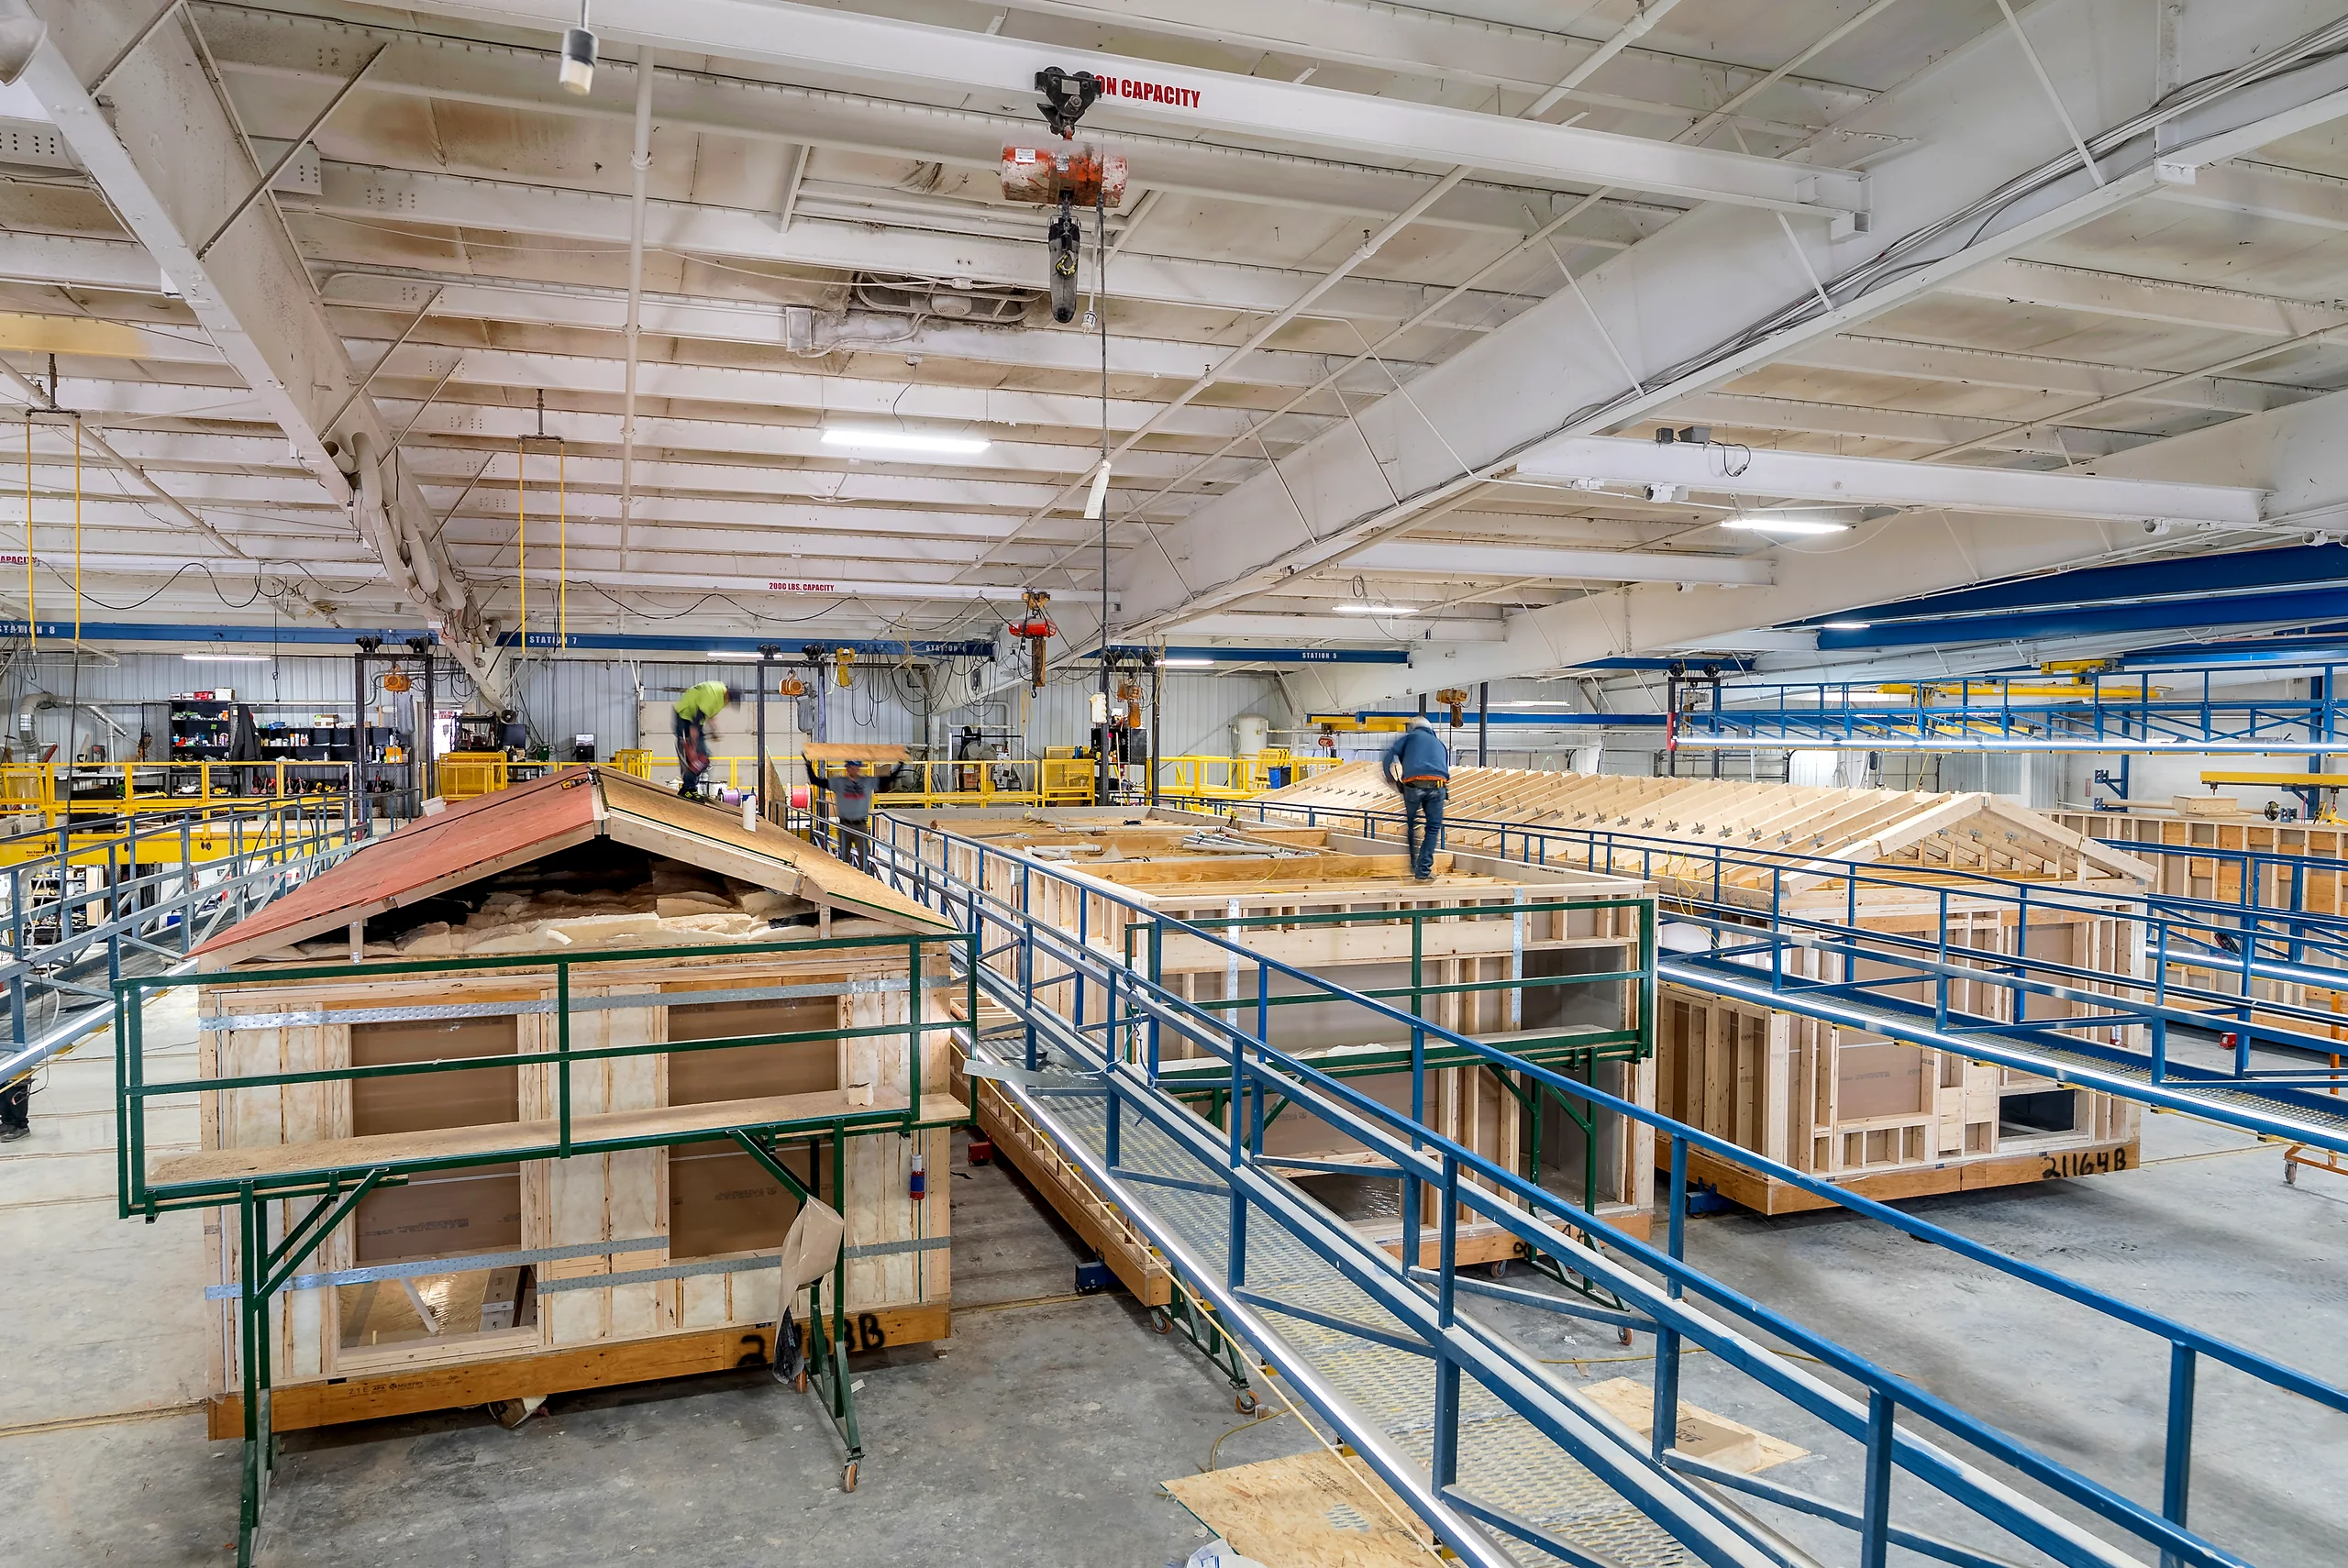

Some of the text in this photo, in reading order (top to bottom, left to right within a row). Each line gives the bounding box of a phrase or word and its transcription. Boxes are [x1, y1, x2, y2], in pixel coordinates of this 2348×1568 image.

[1121, 79, 1201, 108] CAPACITY
[803, 583, 835, 591] CAPACITY
[49, 625, 55, 635] 8
[572, 636, 577, 645] 7
[2042, 1147, 2126, 1179] 21164B
